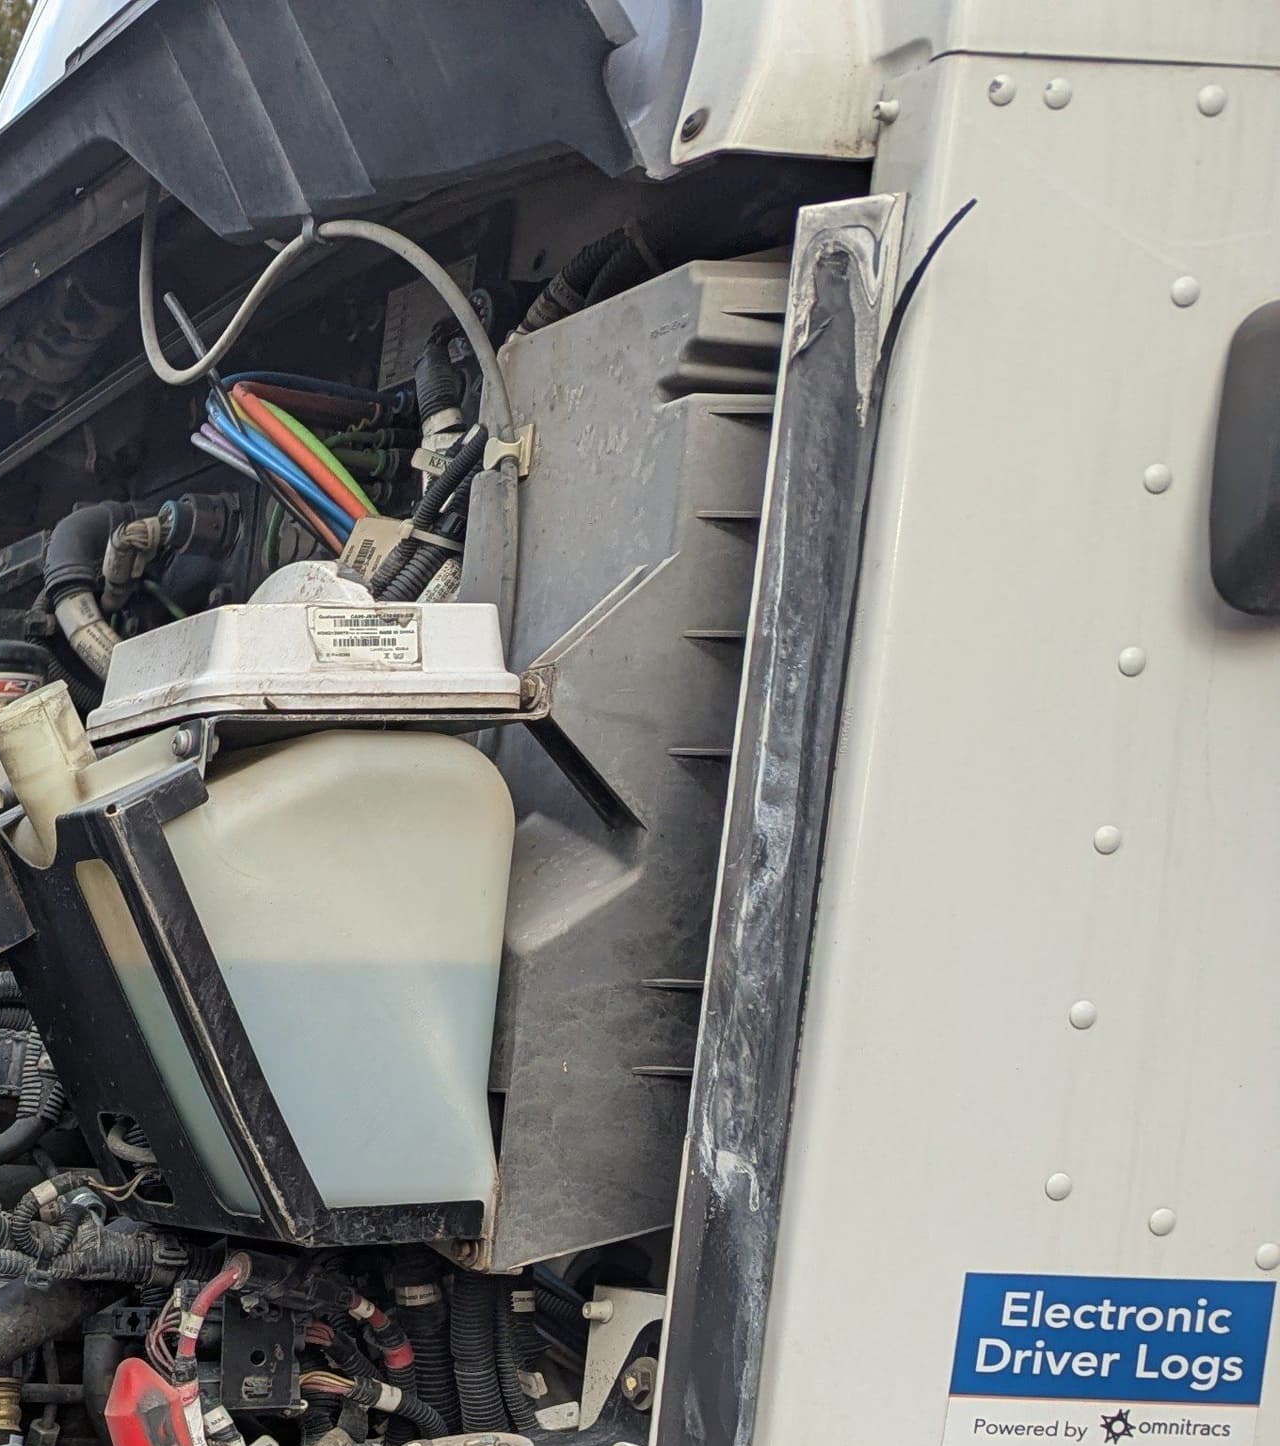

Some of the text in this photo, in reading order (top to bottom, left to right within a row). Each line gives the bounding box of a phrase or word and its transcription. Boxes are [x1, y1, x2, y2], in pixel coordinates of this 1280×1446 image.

[1001, 1290, 1233, 1335] Electronic
[975, 1337, 1244, 1391] Driver Logs
[973, 1418, 1231, 1442] Powered by omnitracs
